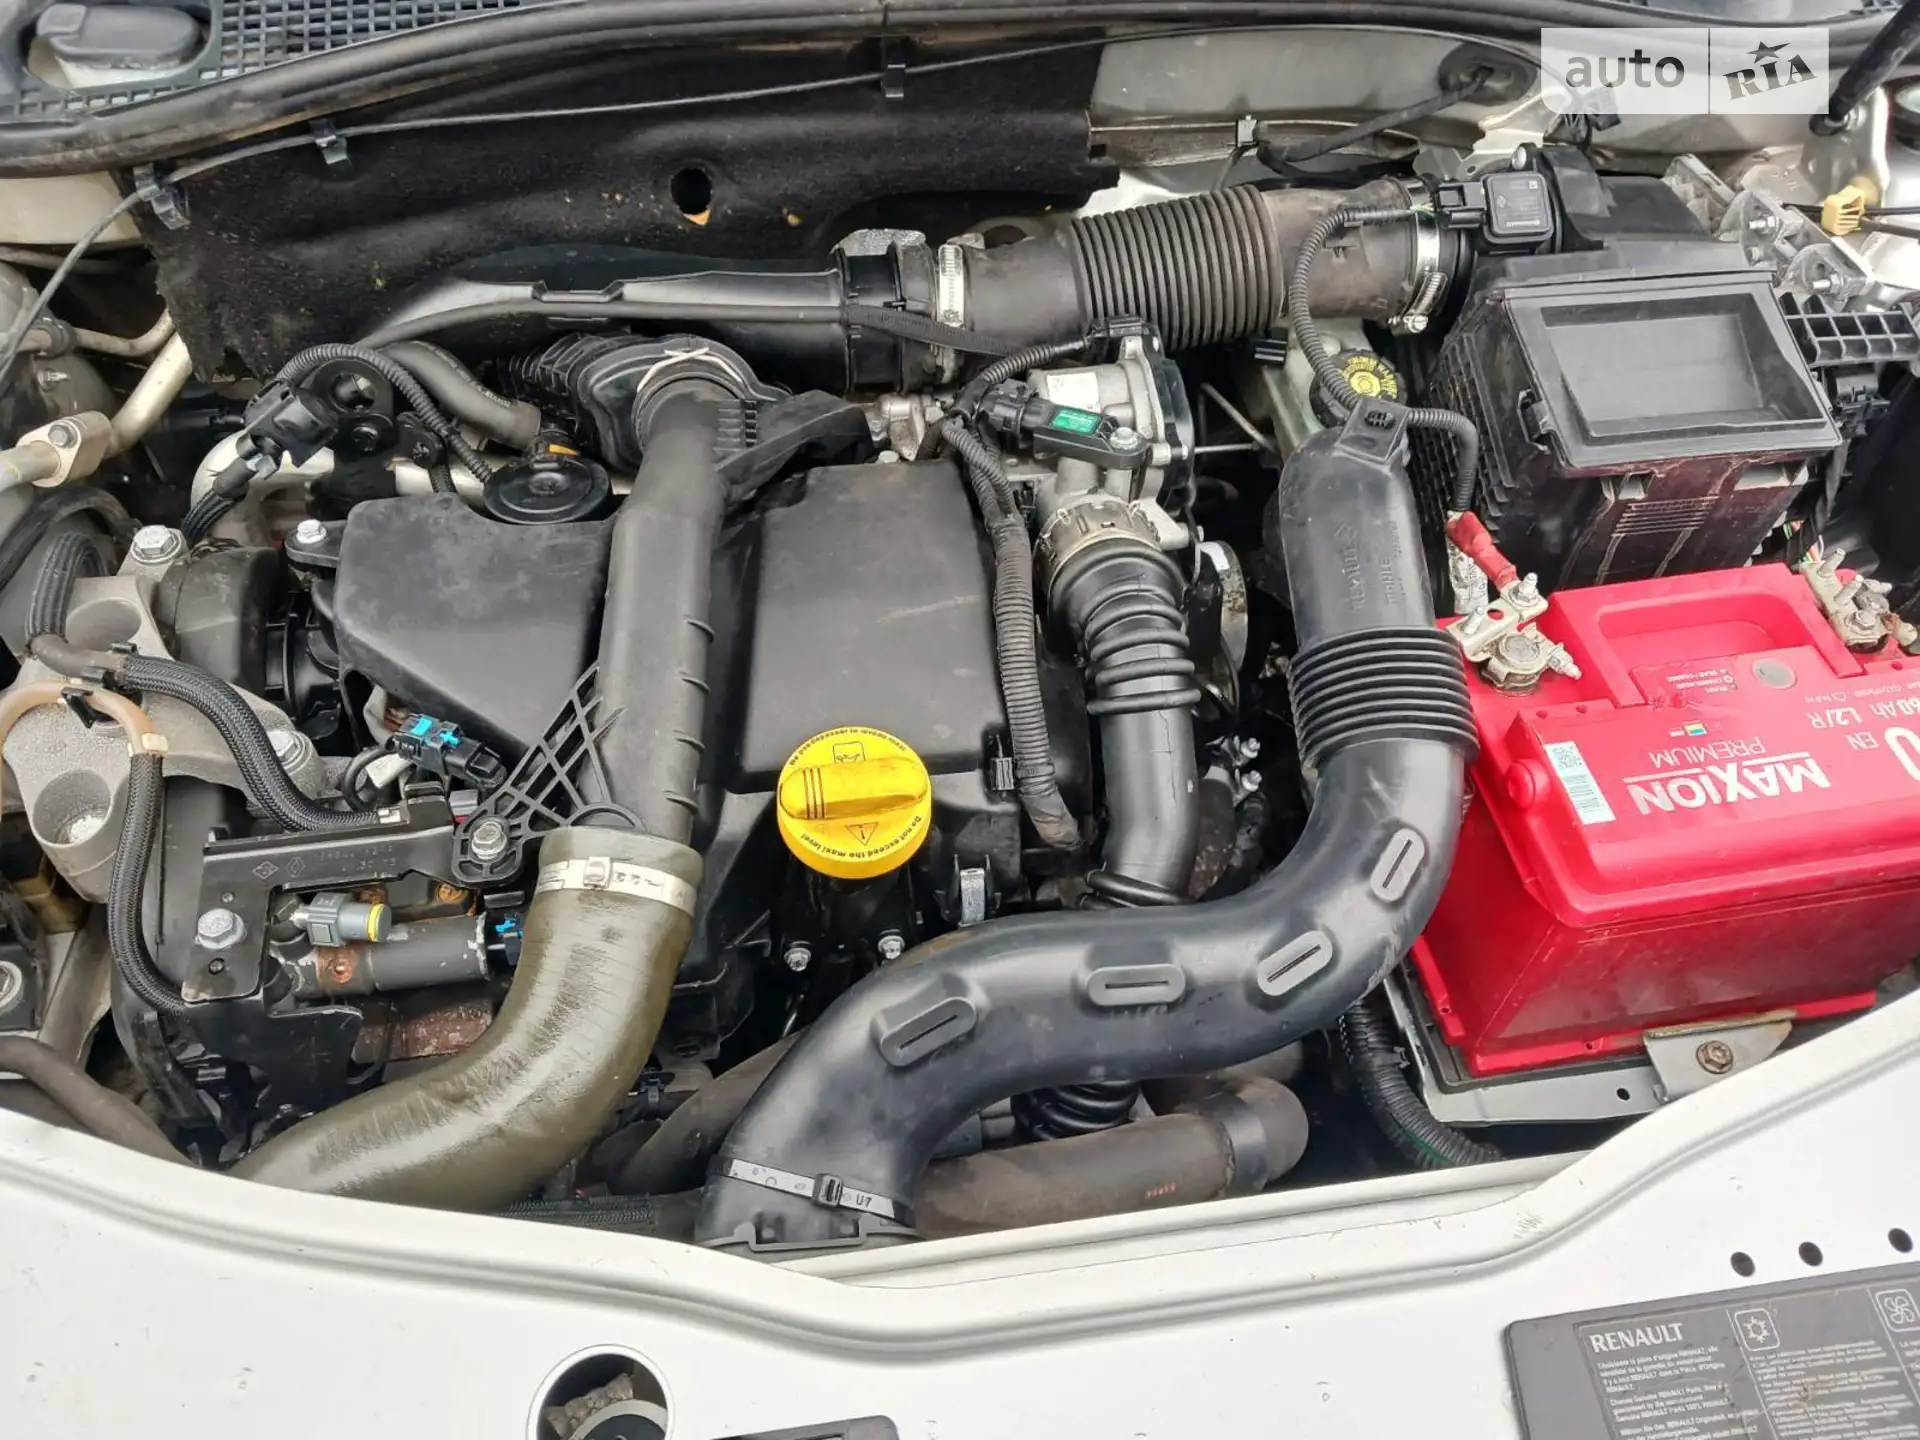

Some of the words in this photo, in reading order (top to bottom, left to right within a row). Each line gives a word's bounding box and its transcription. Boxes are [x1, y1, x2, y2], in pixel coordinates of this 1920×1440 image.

[1805, 707, 1863, 728] L2/R
[1845, 731, 1880, 750] EN
[1648, 736, 1767, 769] PREMIUM
[1627, 758, 1831, 815] MAXION
[911, 815, 922, 827] Do
[800, 833, 822, 851] level
[900, 828, 913, 841] not
[822, 846, 847, 857] maxi
[867, 839, 900, 858] exceed
[856, 1193, 873, 1207] U7
[1590, 1323, 1684, 1352] RENAULT
